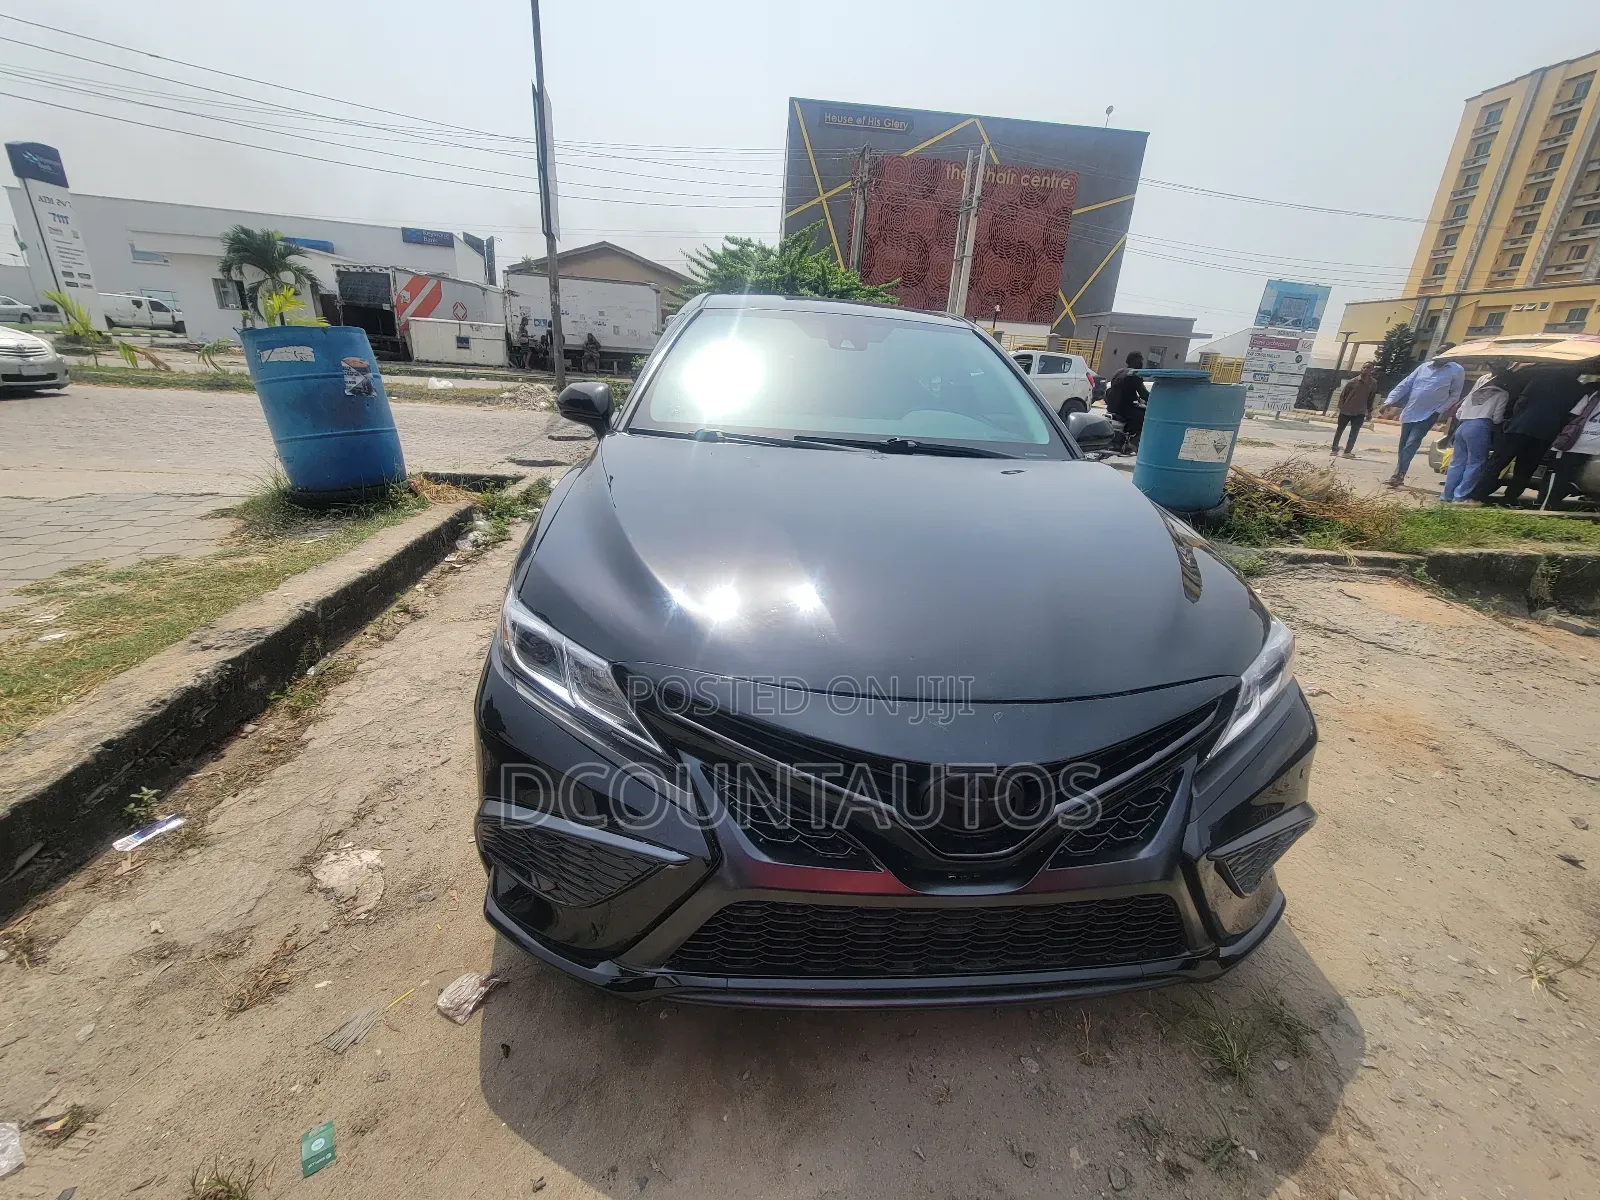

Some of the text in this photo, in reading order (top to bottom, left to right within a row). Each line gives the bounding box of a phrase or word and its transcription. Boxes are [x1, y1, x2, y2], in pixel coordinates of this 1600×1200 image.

[824, 112, 909, 131] House of His Glory
[945, 163, 968, 181] the
